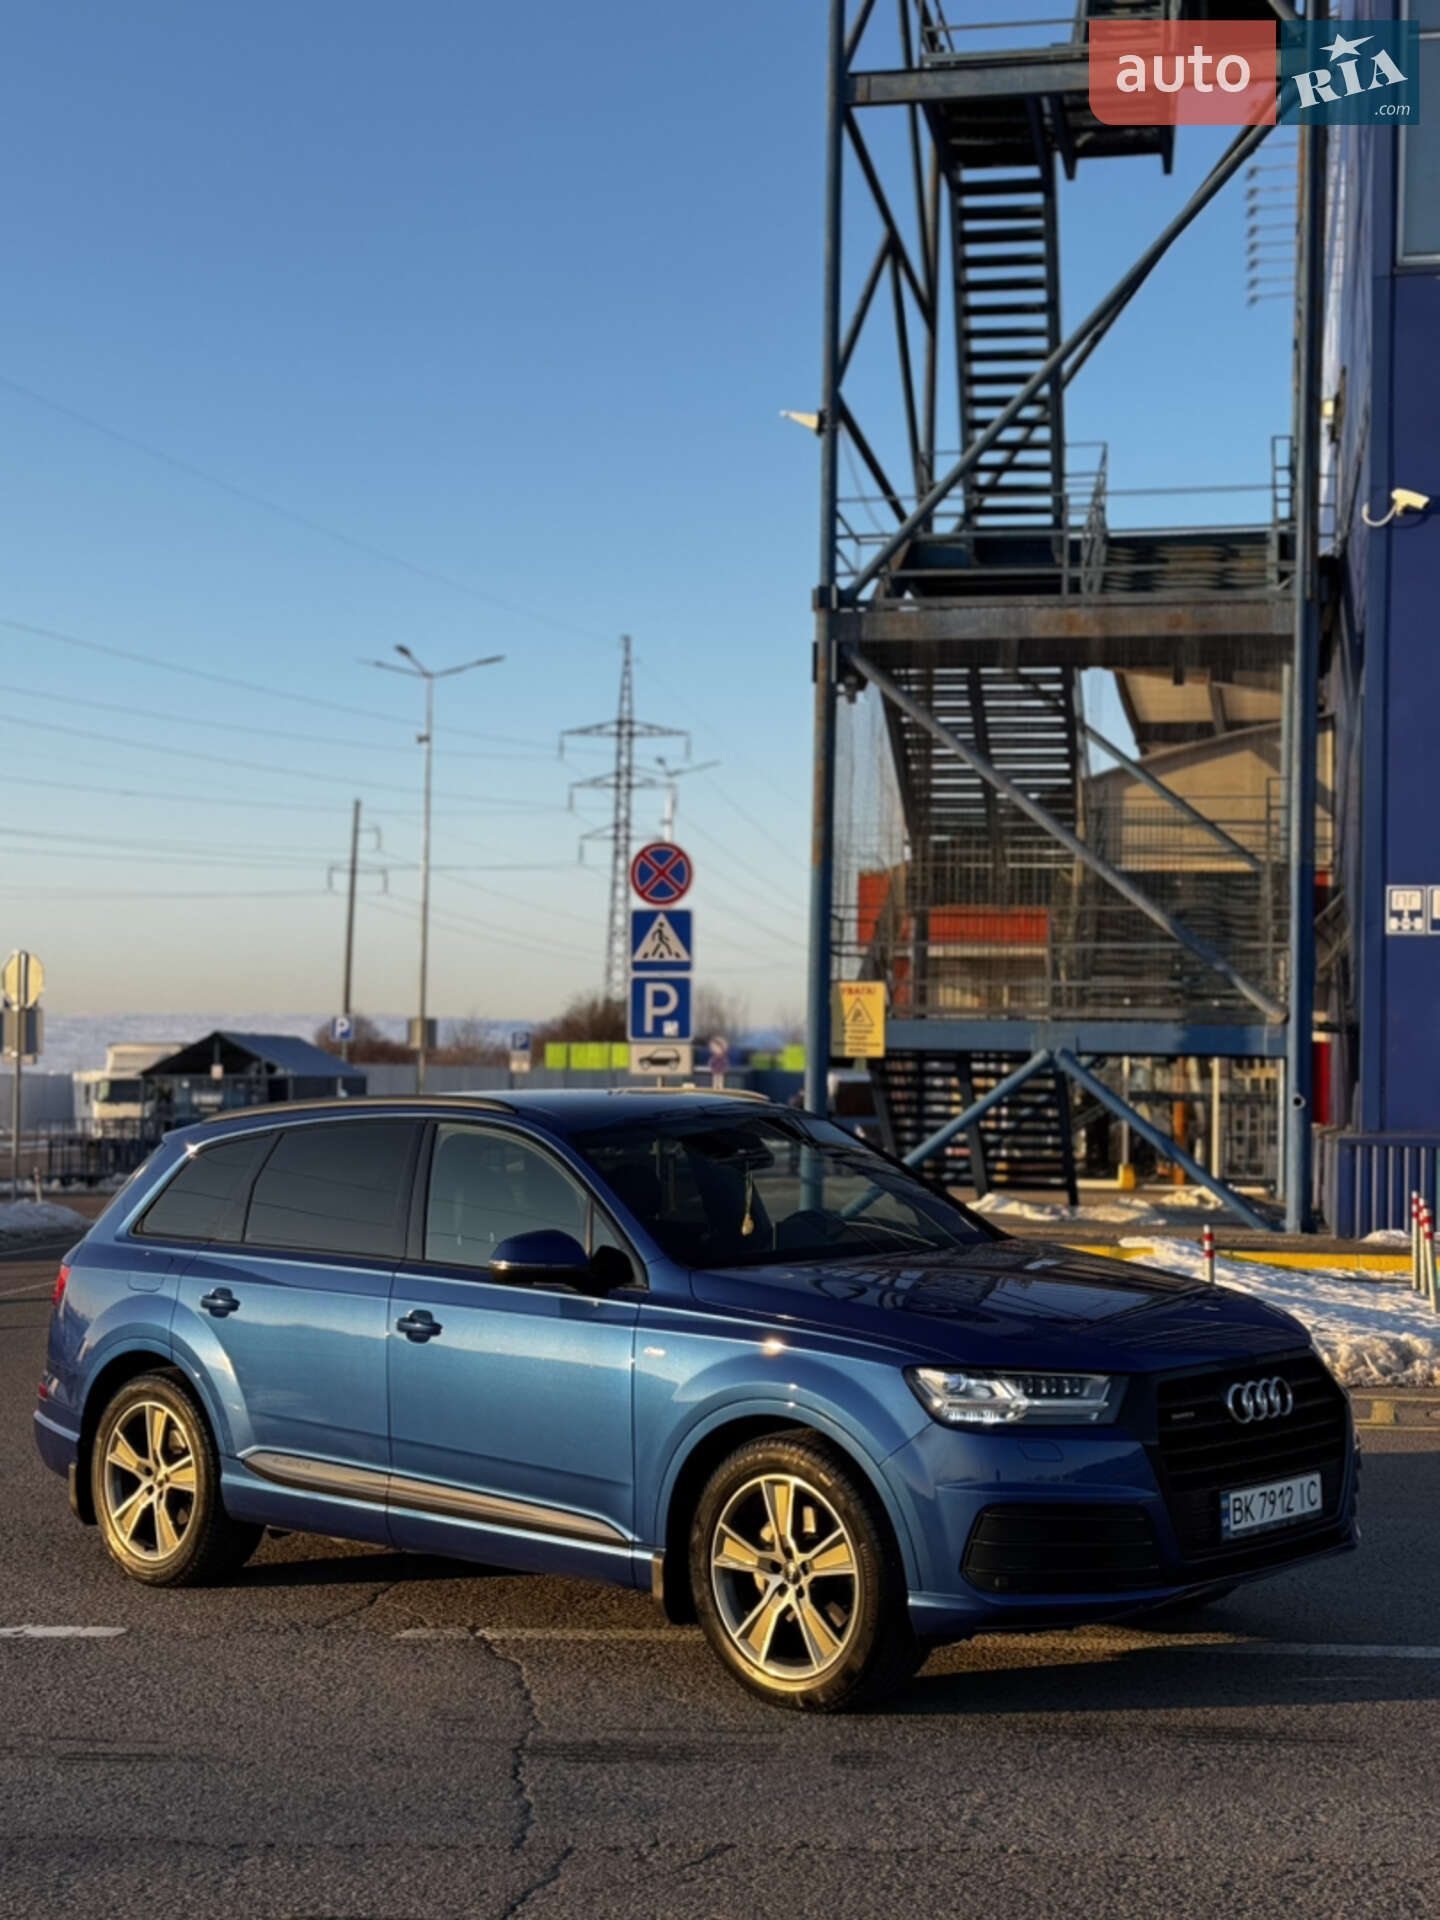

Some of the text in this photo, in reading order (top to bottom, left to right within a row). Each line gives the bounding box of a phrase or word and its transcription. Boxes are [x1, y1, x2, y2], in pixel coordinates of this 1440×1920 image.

[335, 1017, 350, 1040] P
[644, 982, 679, 1034] P
[1232, 1480, 1318, 1526] BK 7912 IC
